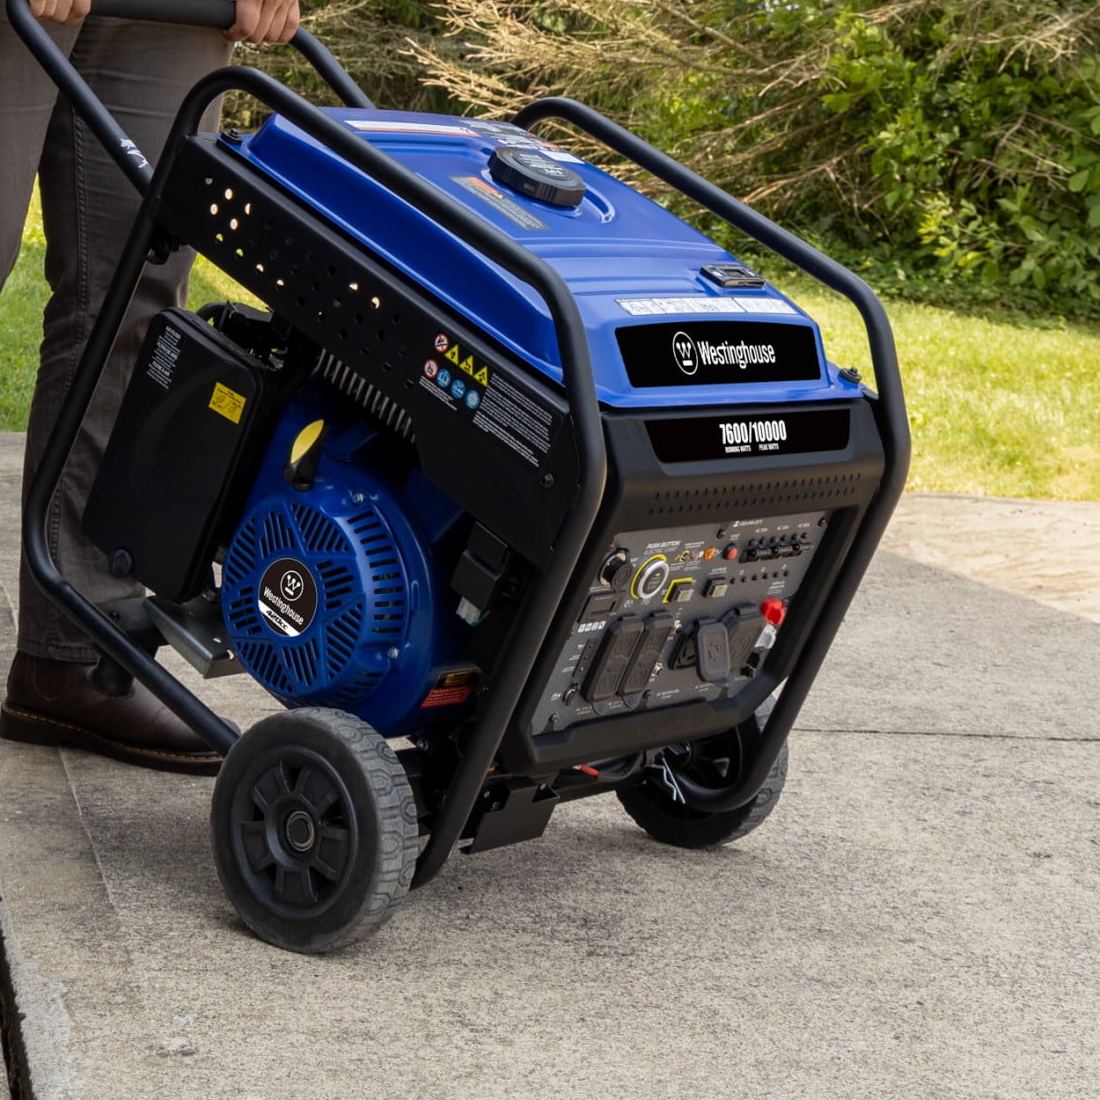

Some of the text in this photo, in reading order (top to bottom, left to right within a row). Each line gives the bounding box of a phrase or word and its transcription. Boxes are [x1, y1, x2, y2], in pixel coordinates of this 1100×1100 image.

[696, 340, 776, 369] Westinghouse
[719, 420, 787, 445] 7600/10000
[263, 586, 304, 626] Westinghouse
